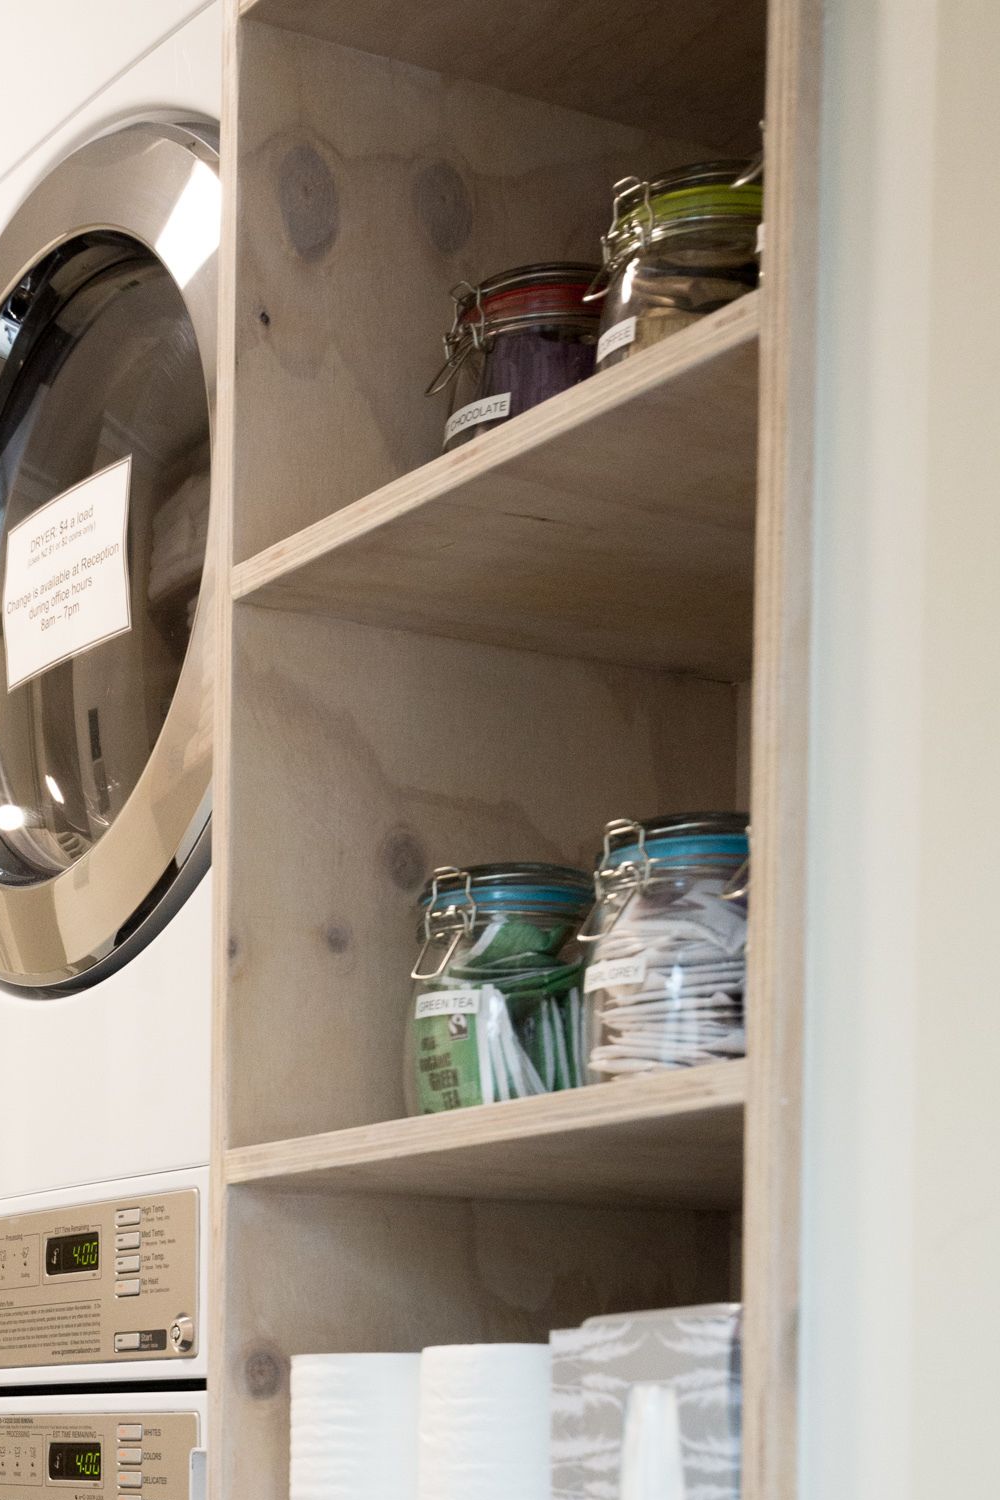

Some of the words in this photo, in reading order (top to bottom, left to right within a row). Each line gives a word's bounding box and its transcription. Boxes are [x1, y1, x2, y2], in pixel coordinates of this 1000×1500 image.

[450, 400, 507, 432] CHOCOLATE
[59, 519, 68, 534] $4
[70, 518, 74, 528] a
[77, 505, 94, 524] load
[7, 592, 31, 615] Change
[33, 586, 38, 598] is
[40, 569, 71, 595] available
[72, 563, 80, 577] at
[81, 543, 120, 571] Reception
[29, 600, 50, 620] during
[50, 589, 70, 607] office
[71, 576, 92, 595] hours
[41, 615, 56, 631] 8am
[64, 602, 80, 620] 7pm
[419, 999, 448, 1013] GREEN
[453, 997, 473, 1008] TEA
[143, 1428, 161, 1437] WHITES
[142, 1452, 162, 1461] COLORS
[142, 1476, 167, 1485] DELICATES
